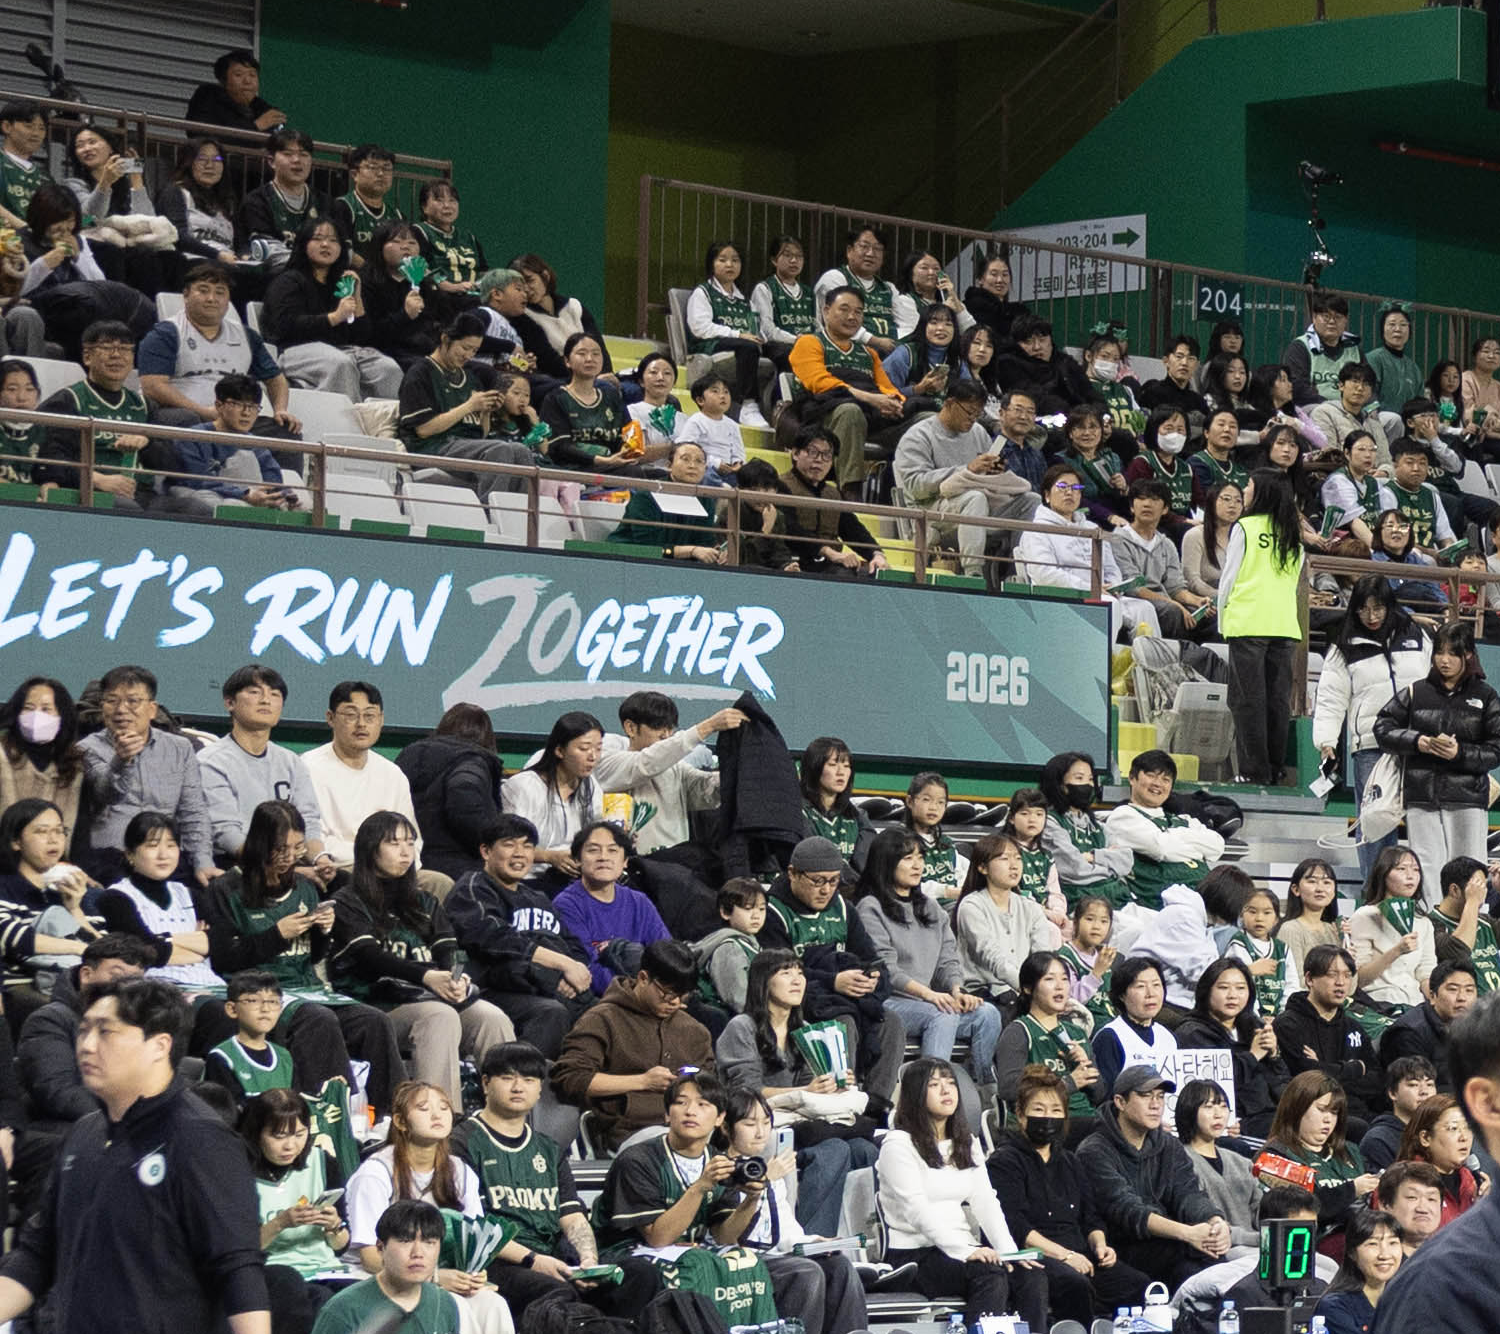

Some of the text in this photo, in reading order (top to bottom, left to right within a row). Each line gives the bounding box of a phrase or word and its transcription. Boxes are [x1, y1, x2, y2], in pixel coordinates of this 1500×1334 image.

[1199, 286, 1243, 315] 204
[0, 531, 224, 652] LET'S
[244, 564, 453, 670] RUN
[946, 650, 1031, 707] 2026
[1159, 1053, 1233, 1087] 사랑해요
[490, 1184, 559, 1214] PROMY
